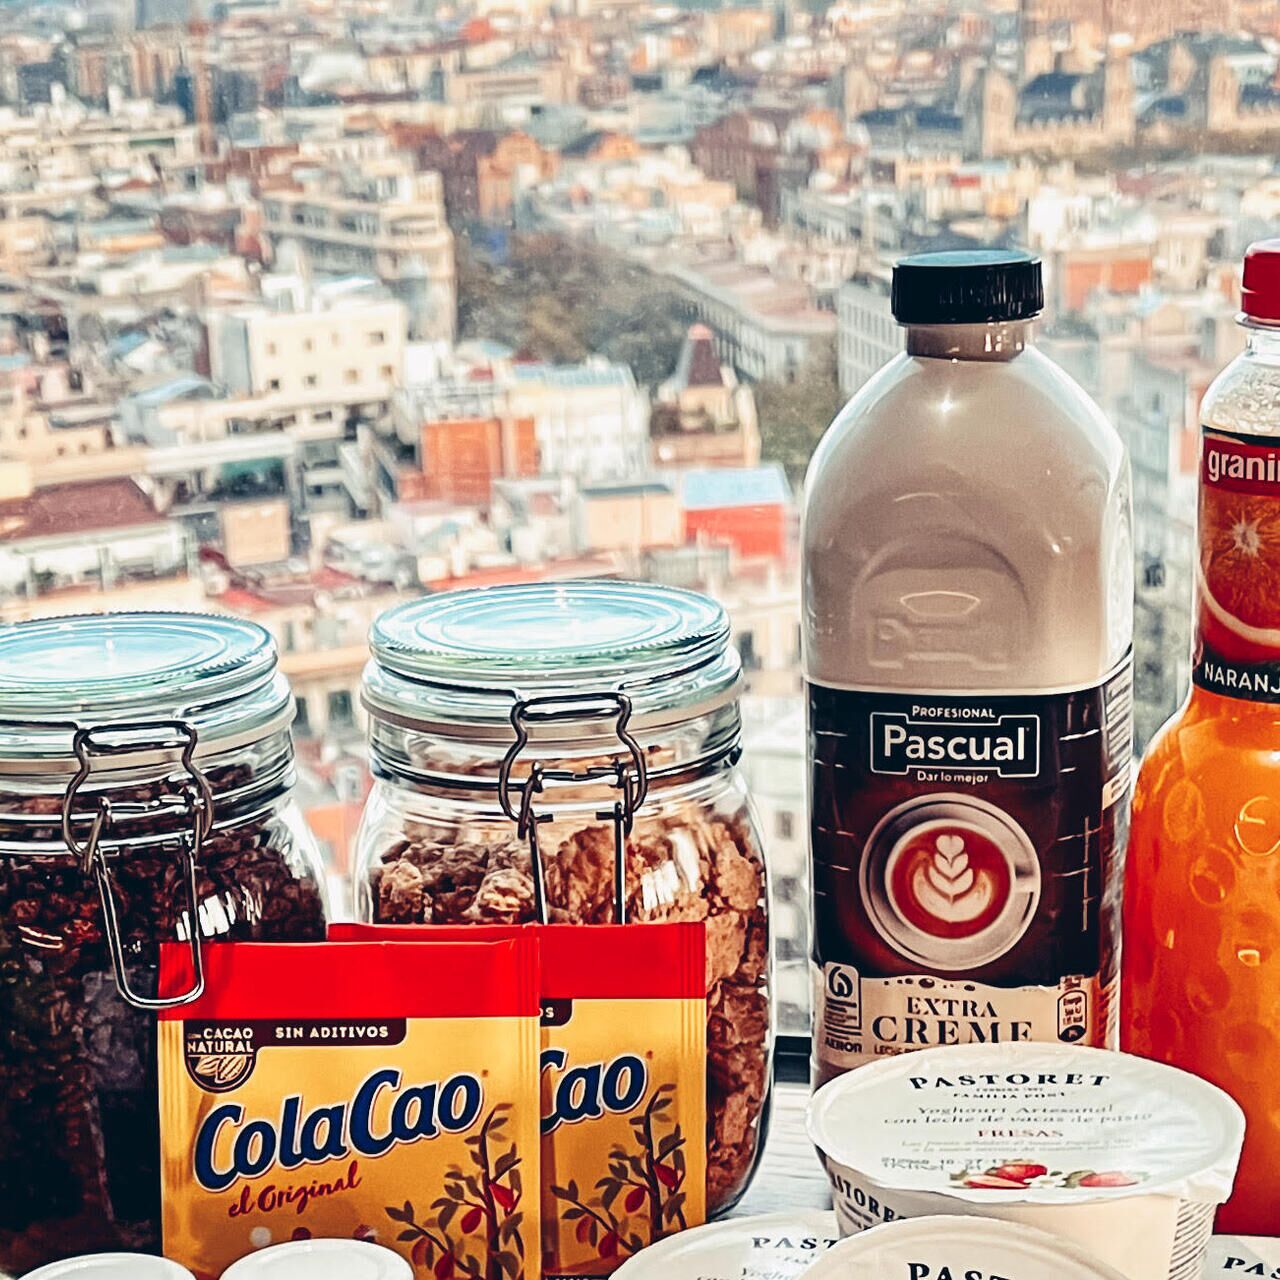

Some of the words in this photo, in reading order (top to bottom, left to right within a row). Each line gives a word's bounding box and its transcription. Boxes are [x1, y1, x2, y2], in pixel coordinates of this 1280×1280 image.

[912, 705, 996, 719] PROFESIONAL
[884, 724, 1025, 761] Pascual
[917, 771, 938, 782] Dar
[940, 771, 952, 782] lo
[953, 773, 989, 785] mejor
[907, 996, 998, 1018] EXTRA
[203, 1027, 254, 1040] CACAO
[275, 1026, 304, 1039] SIN
[309, 1026, 389, 1040] ADITIVOS
[872, 1016, 1033, 1044] CREME
[187, 1040, 254, 1054] NATURAL
[909, 1073, 1111, 1090] PASTORET
[194, 1069, 484, 1192] ColaCao
[977, 1130, 1065, 1138] FRESAS
[228, 1186, 255, 1218] el
[257, 1160, 362, 1214] Original
